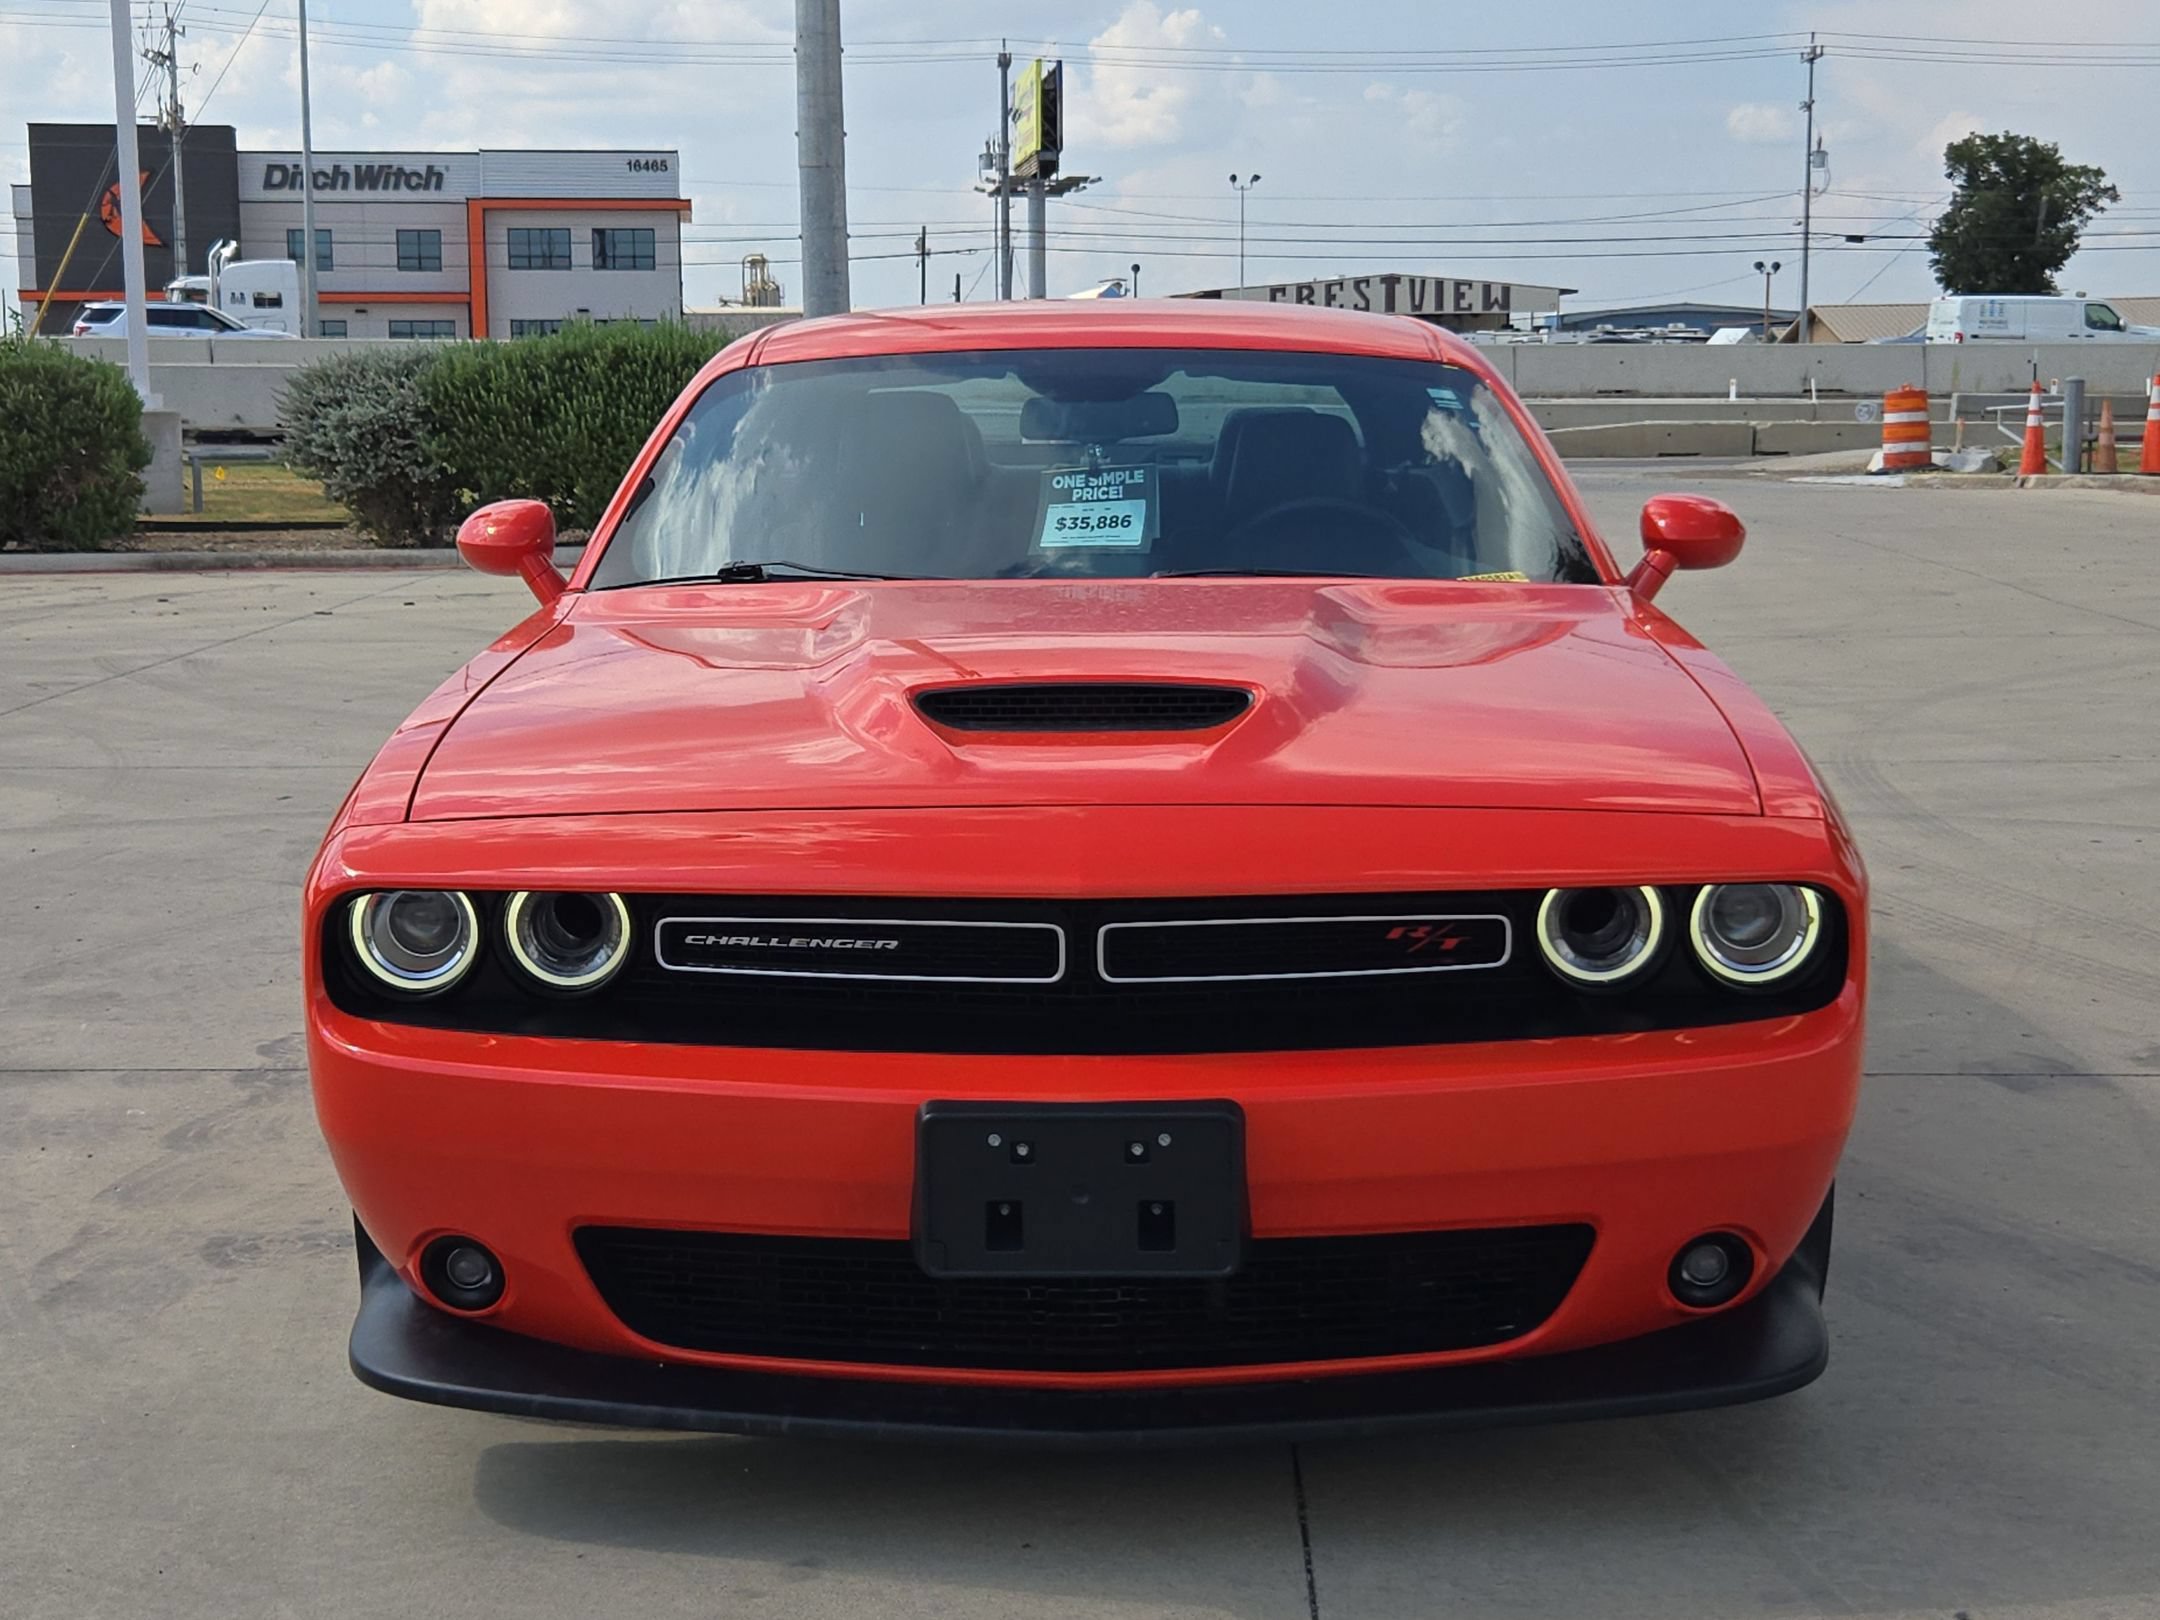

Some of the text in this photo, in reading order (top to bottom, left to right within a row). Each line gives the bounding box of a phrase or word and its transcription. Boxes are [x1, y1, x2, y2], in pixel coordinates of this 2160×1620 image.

[626, 159, 668, 172] 16465
[354, 164, 444, 191] Witch
[1269, 277, 1511, 313] CRESTVIEW
[1052, 469, 1144, 489] ONE SIMPLE
[1072, 485, 1123, 501] PRICE!
[1054, 514, 1132, 532] $35,886
[684, 935, 899, 950] CHALLENGER
[1385, 922, 1472, 953] R/T
